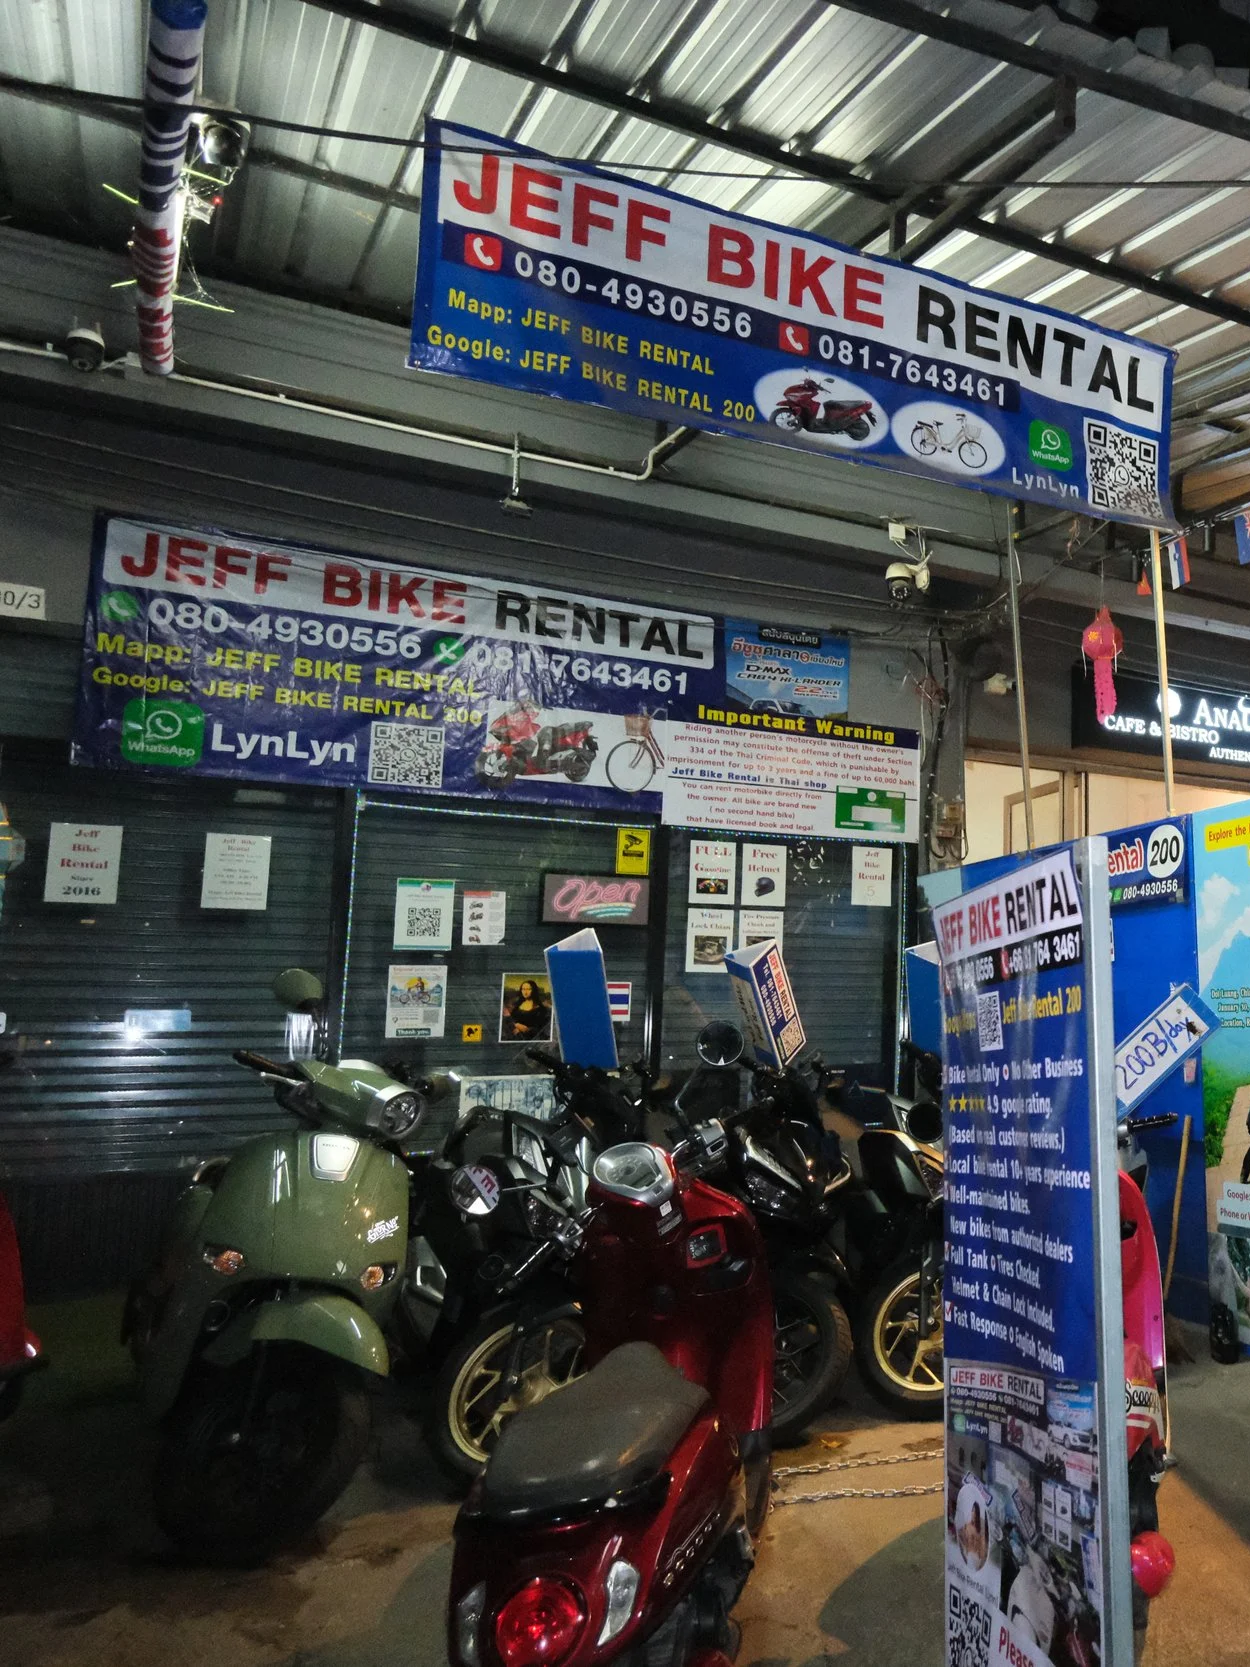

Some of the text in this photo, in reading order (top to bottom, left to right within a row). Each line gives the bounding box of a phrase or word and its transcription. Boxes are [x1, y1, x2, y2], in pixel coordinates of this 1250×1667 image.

[453, 154, 1154, 414] JEFF BIKE RENTAL
[514, 252, 752, 338] 080-4930556
[448, 288, 714, 376] Mapp: JEFF BIKE RENTAL
[427, 325, 755, 422] Google: JEFF BIKE RENTAL 200
[818, 334, 1005, 407] 081-7643461
[1032, 450, 1070, 465] WhatsApp
[1012, 467, 1080, 499] LynLyn
[0, 590, 40, 610] 0/3
[120, 533, 704, 659] JEFF BIKE RENTAL
[149, 598, 422, 659] 080-4930556
[97, 633, 480, 697] Mapp: JEFF BIKE RENTAL
[470, 640, 688, 695] 081-7643461
[92, 667, 482, 724] Google: JEFF BIKE RENTAL 200
[698, 705, 895, 745] Important Warning
[1104, 716, 1220, 745] CAFE & BISTRO
[211, 723, 356, 765] LynLyn
[672, 767, 827, 790] Jeff Bike Rental is Thai shop
[715, 785, 732, 794] rent
[734, 787, 773, 796] motorbike
[775, 791, 802, 800] directly
[71, 843, 98, 853] Bike
[74, 829, 100, 838] Jeff
[1208, 829, 1233, 843] Explore
[1235, 826, 1246, 837] the
[60, 858, 109, 870] Rental
[748, 864, 780, 874] Helmet
[752, 849, 778, 859] Free
[1108, 835, 1180, 874] ental 200
[62, 886, 101, 896] 2016
[554, 879, 641, 919] Open
[1123, 879, 1178, 900] 080-4930556
[940, 871, 1078, 955] JEFF BIKE RENTAL
[1227, 1189, 1250, 1201] Google:
[953, 1306, 968, 1327] Fast
[970, 1311, 1007, 1342] Response
[1037, 1337, 1065, 1373] Spoken
[952, 1369, 1042, 1401] JEFF BIKE RENTAL
